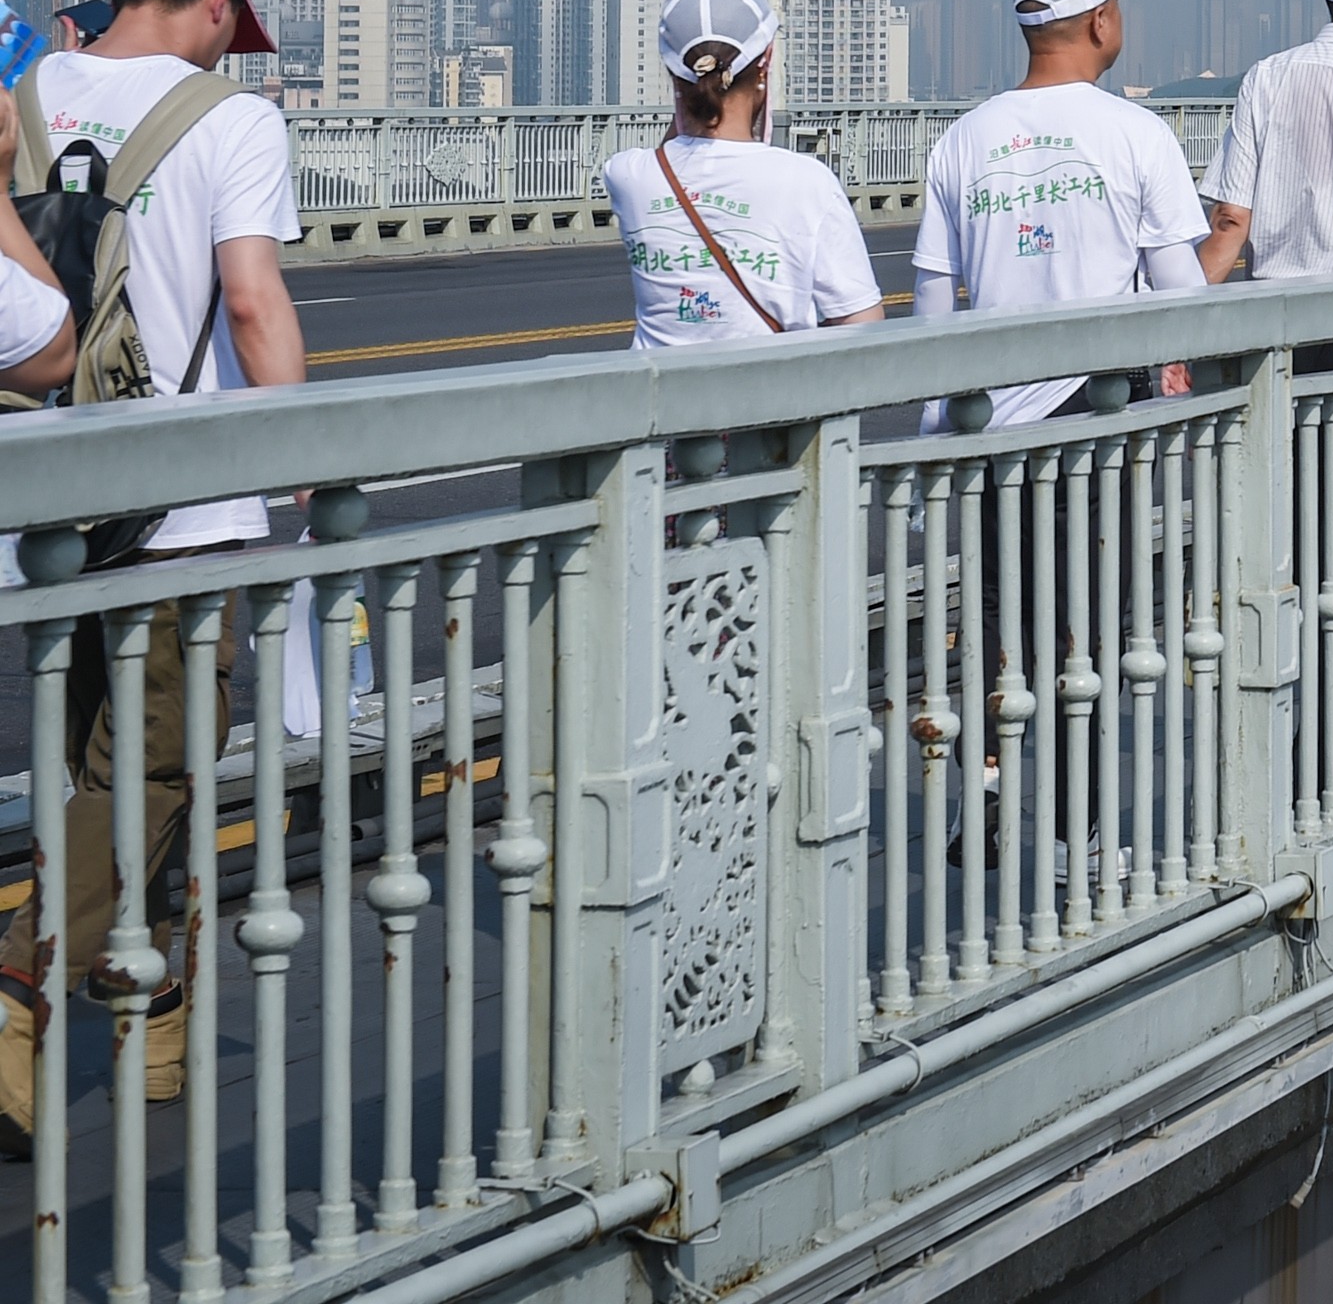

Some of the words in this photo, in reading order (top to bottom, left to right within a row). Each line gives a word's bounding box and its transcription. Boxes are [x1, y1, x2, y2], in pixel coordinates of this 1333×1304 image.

[965, 172, 1105, 221] 湖北千里长江行
[627, 239, 781, 282] 湖北千里江行
